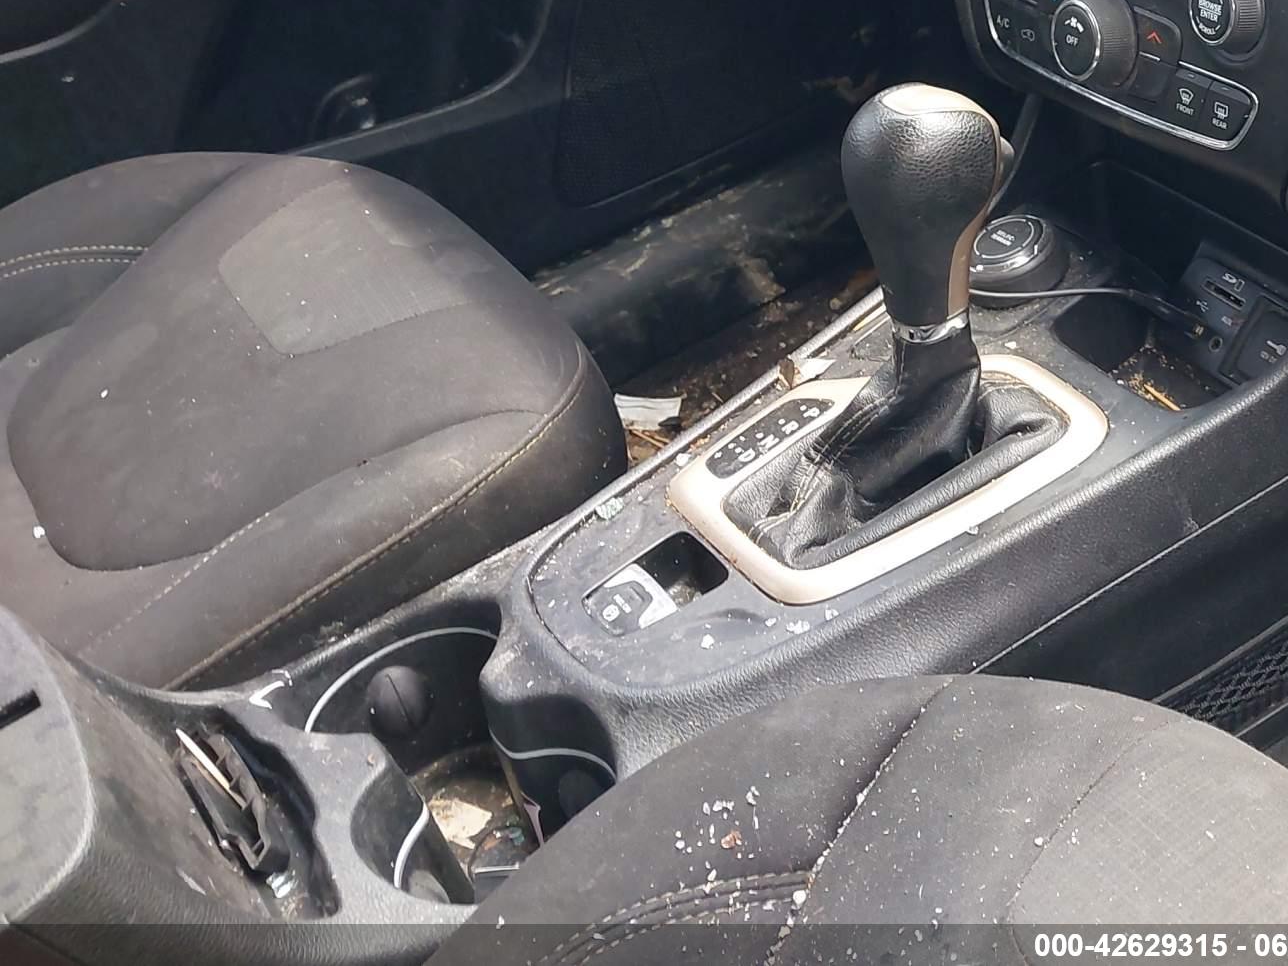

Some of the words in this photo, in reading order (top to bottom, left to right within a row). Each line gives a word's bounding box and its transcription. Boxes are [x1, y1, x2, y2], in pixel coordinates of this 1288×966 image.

[996, 14, 1010, 28] A/C
[1200, 9, 1219, 23] ENTER
[1066, 35, 1079, 47] OFF
[1176, 103, 1194, 115] FRONT
[803, 407, 820, 418] P
[782, 420, 799, 435] R
